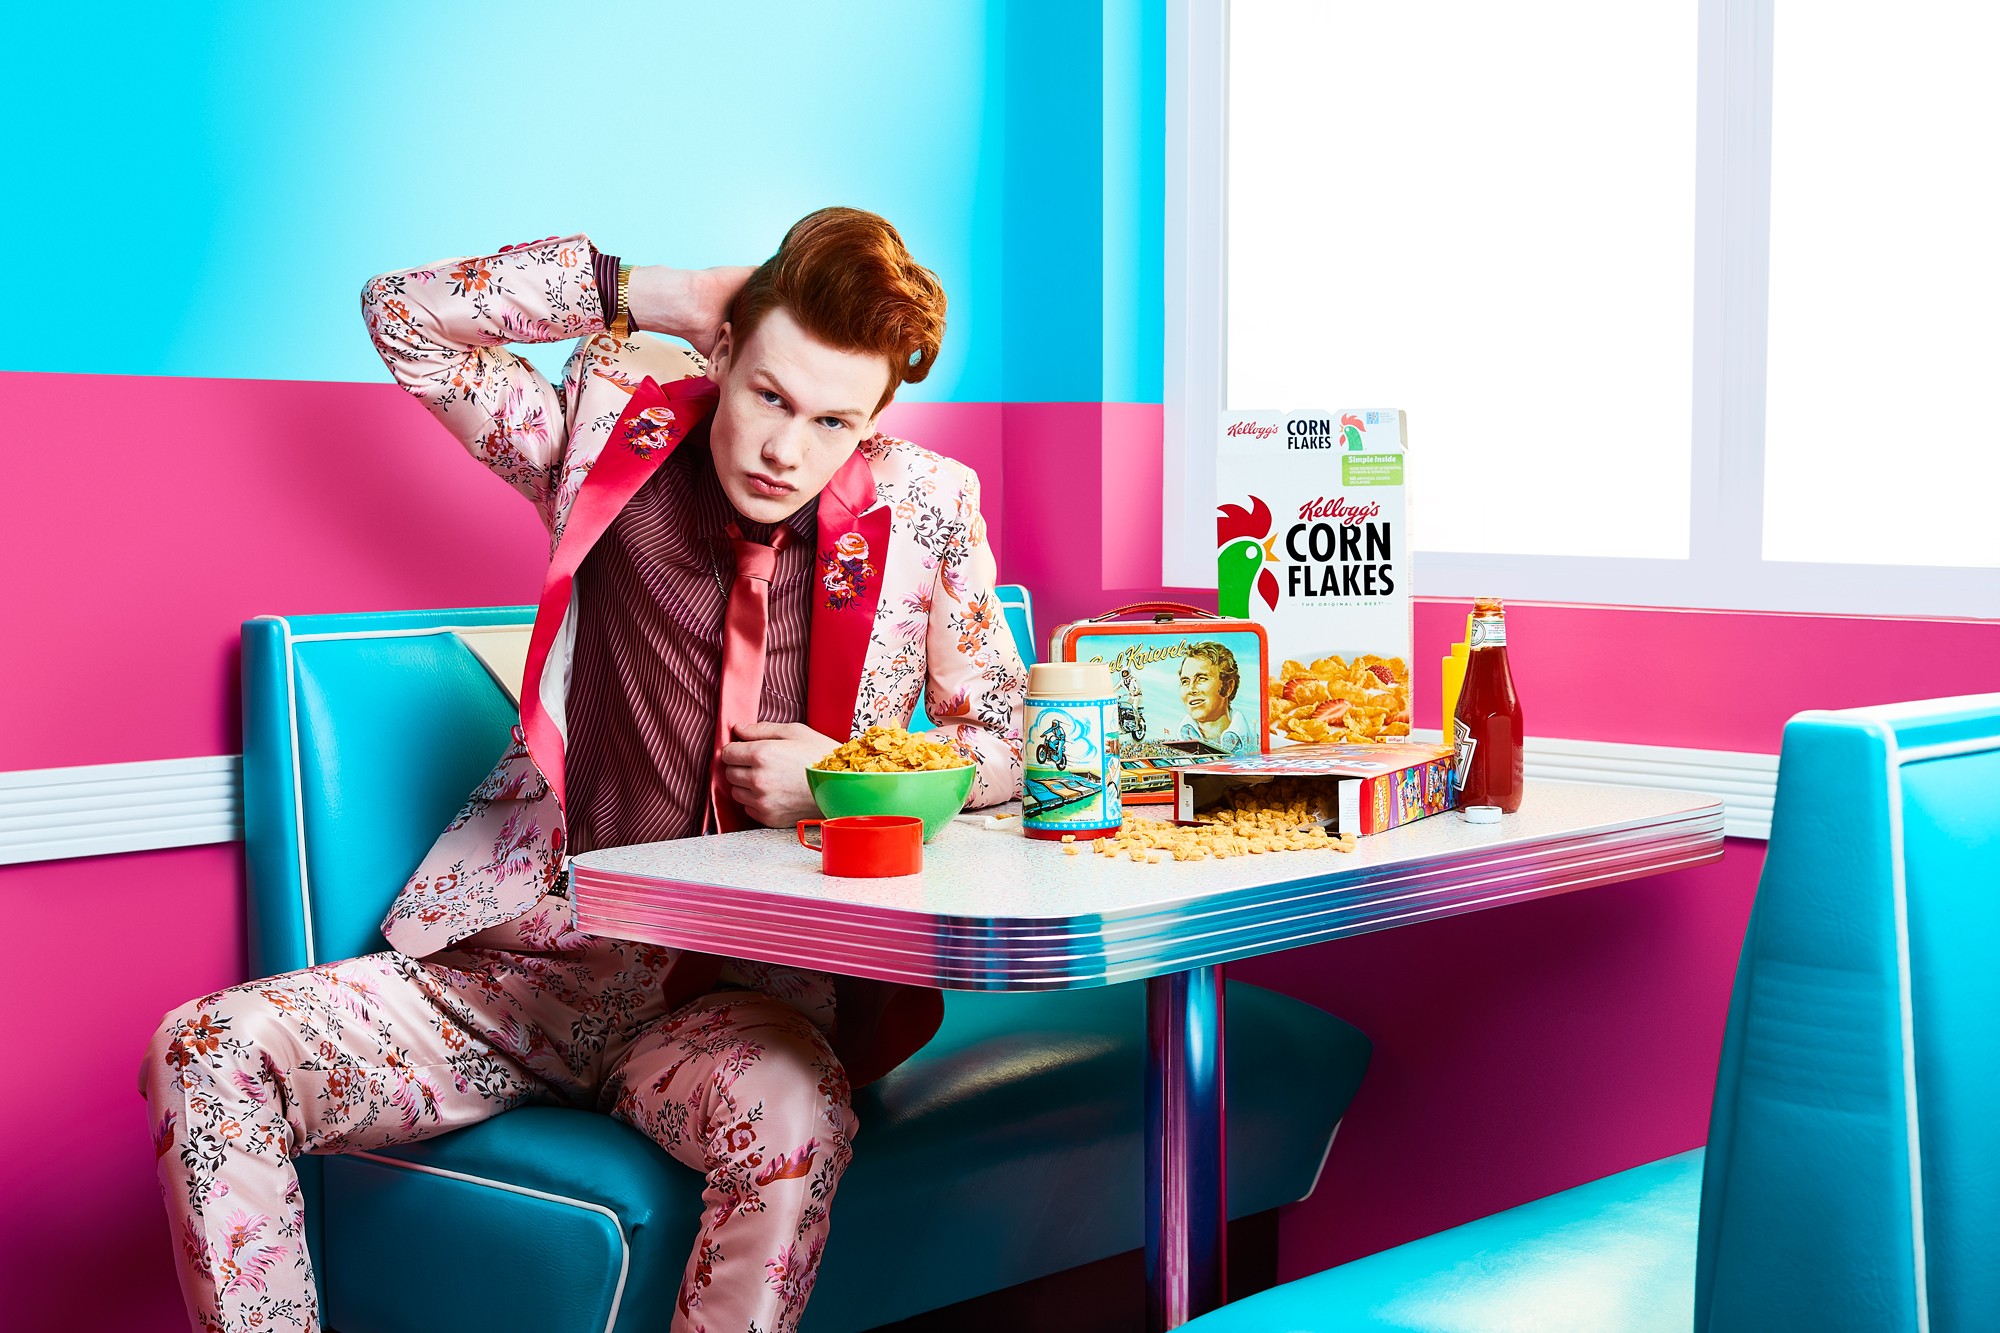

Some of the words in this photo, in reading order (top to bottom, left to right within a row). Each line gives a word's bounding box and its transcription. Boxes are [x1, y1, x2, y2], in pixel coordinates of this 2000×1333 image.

[1227, 421, 1279, 439] Kellogg's
[1287, 420, 1330, 435] CORN
[1288, 436, 1331, 449] FLAKES
[1348, 456, 1373, 464] Simple
[1298, 496, 1380, 525] Kellogg's
[1286, 522, 1390, 562] CORN
[1288, 564, 1394, 597] FLAKES
[1125, 638, 1187, 670] Knievel
